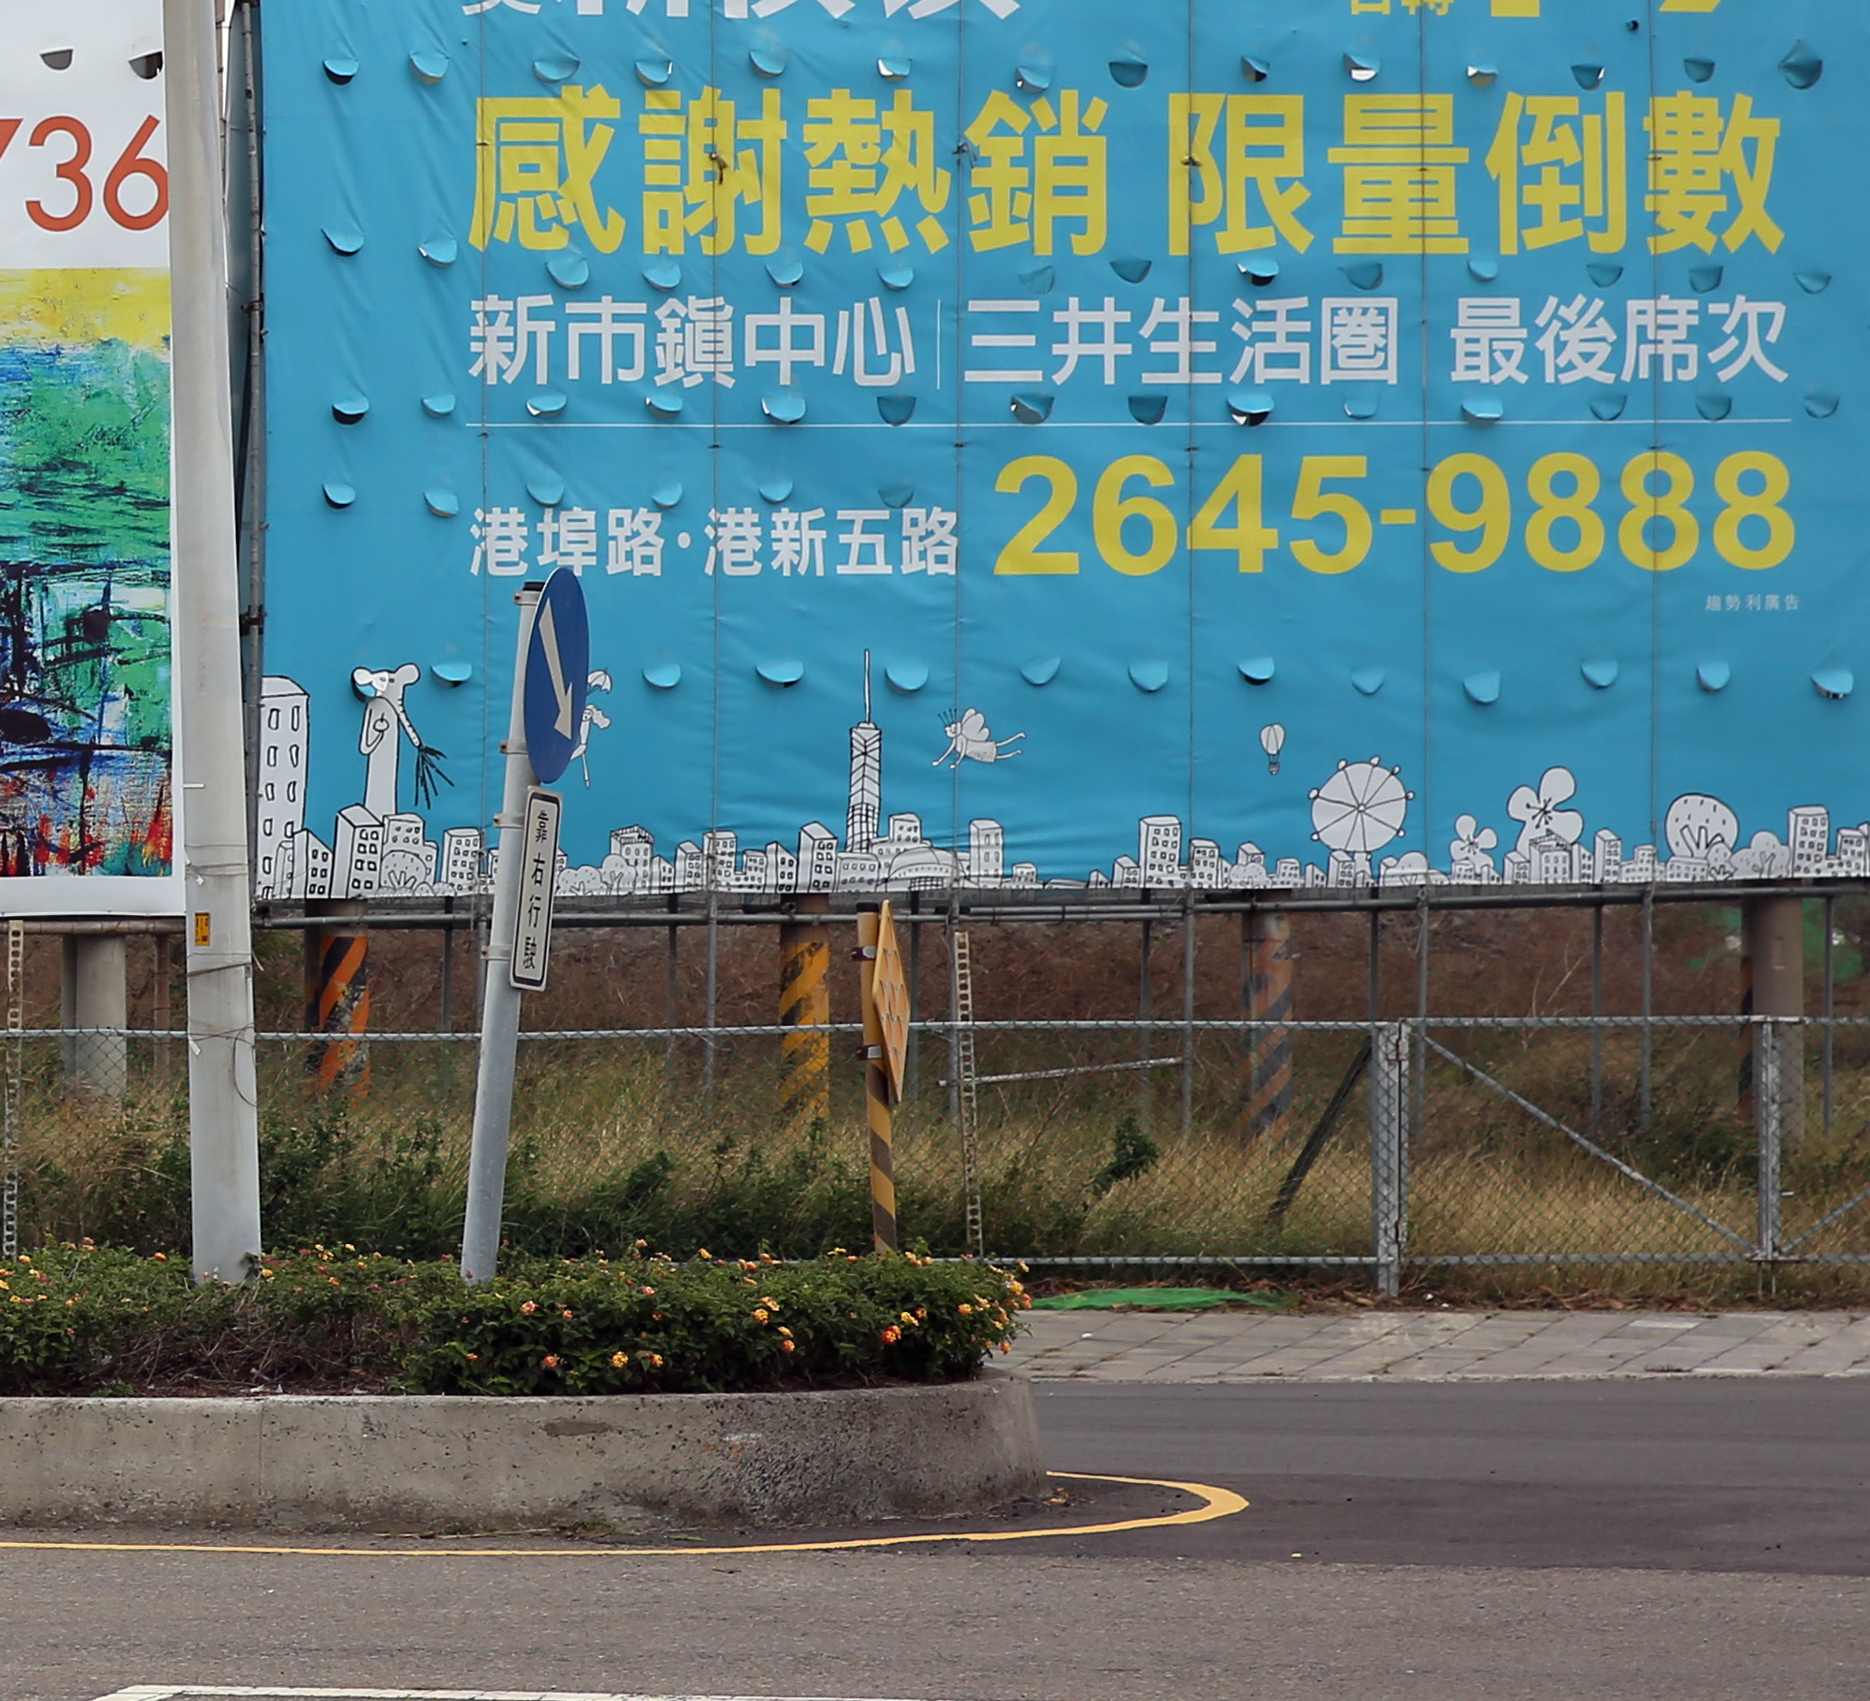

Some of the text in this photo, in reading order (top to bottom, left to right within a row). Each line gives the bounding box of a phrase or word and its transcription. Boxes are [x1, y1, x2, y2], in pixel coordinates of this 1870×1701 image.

[468, 84, 1785, 256] 感謝熱銷 限量倒數
[964, 296, 1399, 386] 三井生活圈
[1450, 294, 1789, 385] 最後席次
[994, 450, 1796, 576] 2645-9888
[522, 810, 549, 969] 靠右行駛
